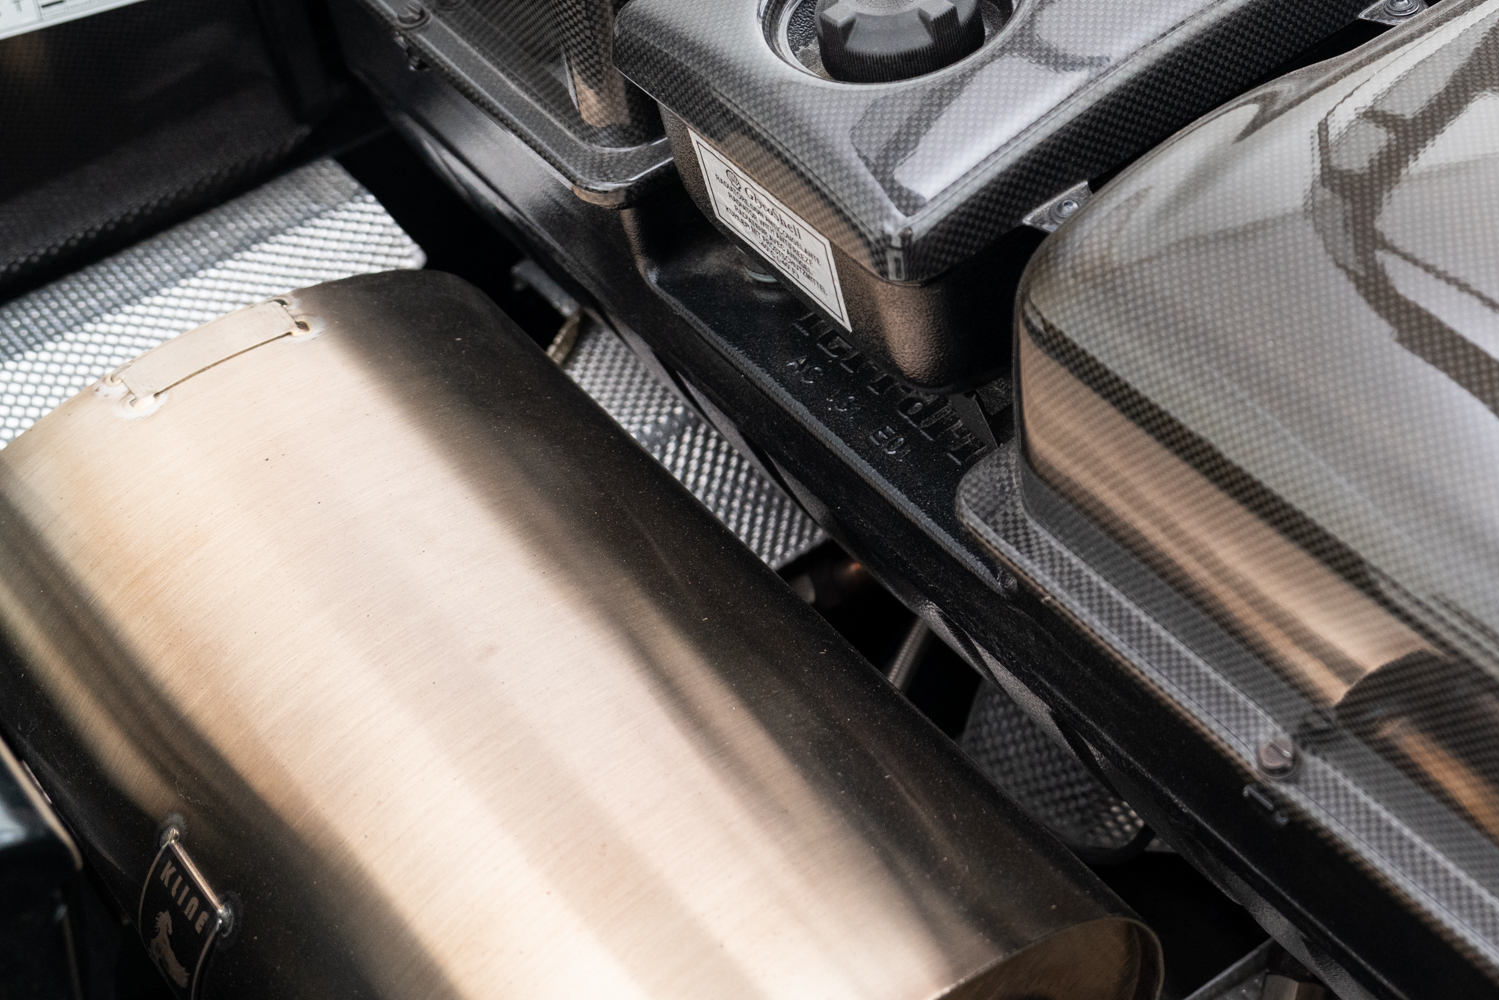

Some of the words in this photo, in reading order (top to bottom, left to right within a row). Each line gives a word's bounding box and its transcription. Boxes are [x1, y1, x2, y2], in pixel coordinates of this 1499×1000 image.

[728, 192, 757, 221] RADIATOR
[759, 218, 774, 236] WITH
[776, 232, 813, 268] ANTIFREEZE
[744, 186, 802, 241] GlycoShell
